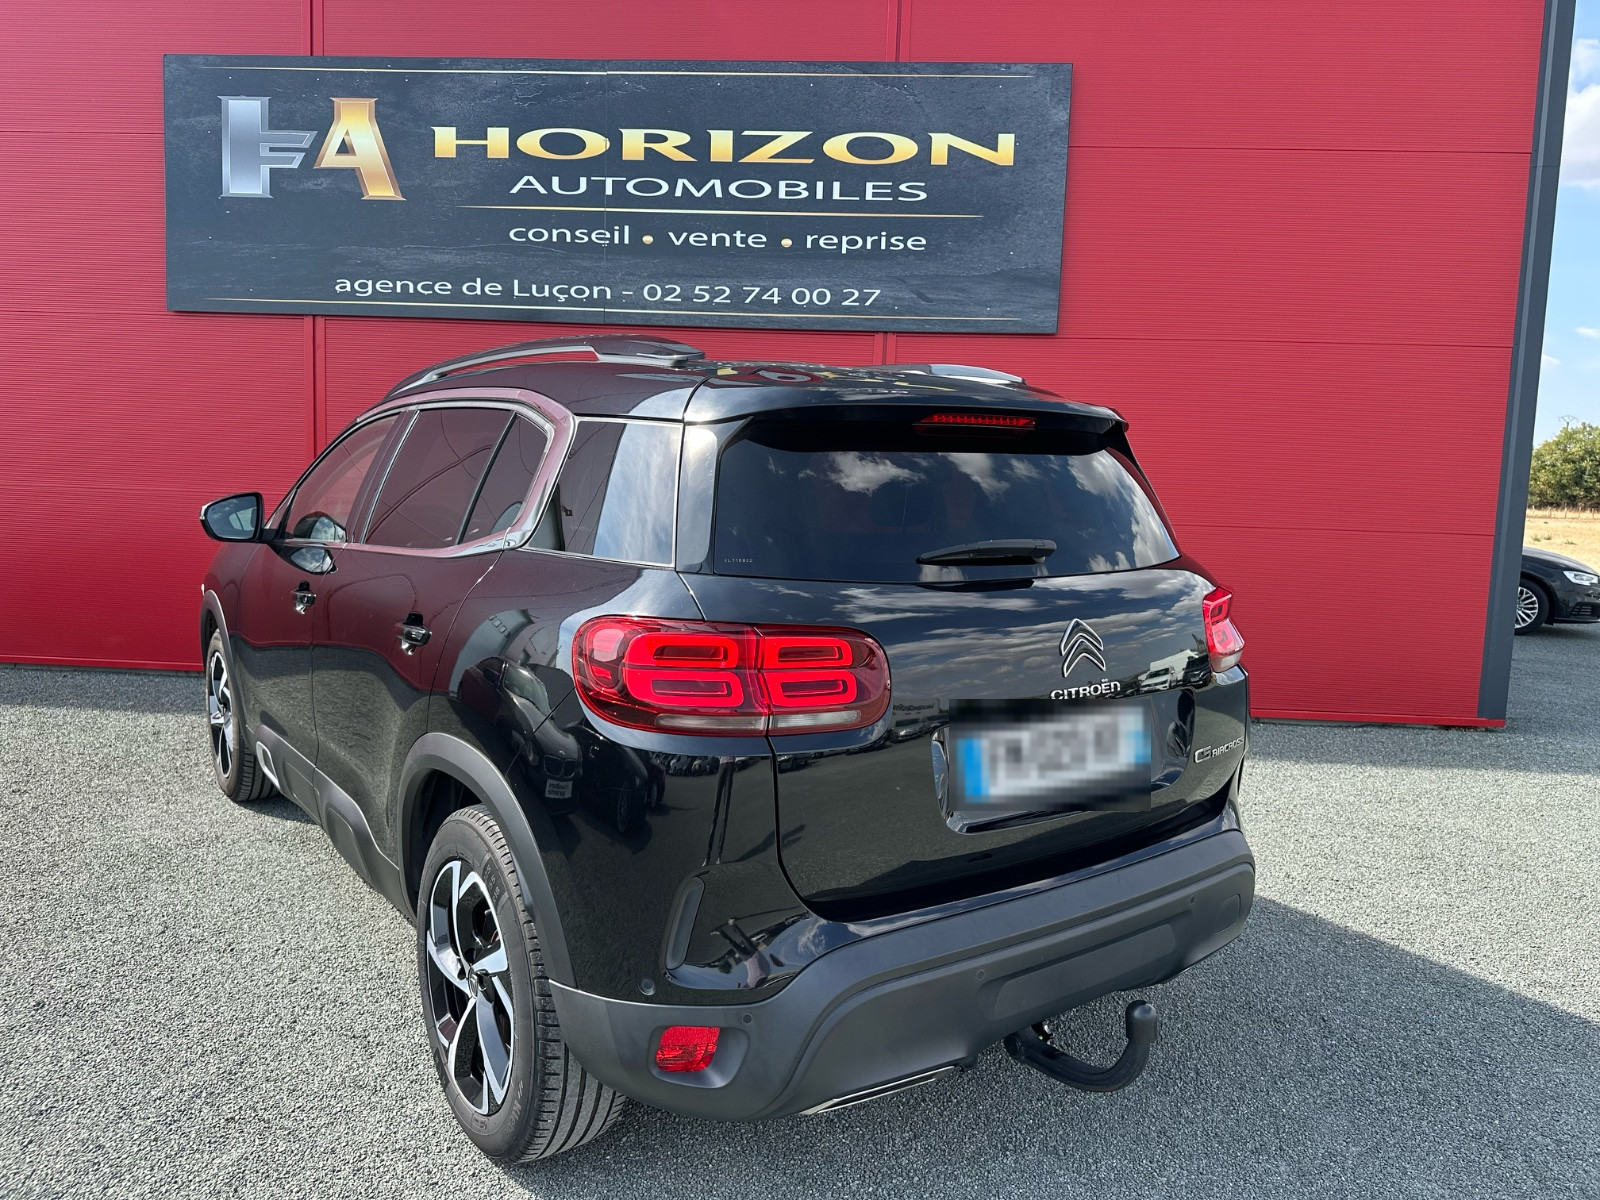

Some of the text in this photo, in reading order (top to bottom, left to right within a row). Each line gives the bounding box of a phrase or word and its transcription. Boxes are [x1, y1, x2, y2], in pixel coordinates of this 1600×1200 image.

[431, 126, 1016, 166] HORIZON
[509, 175, 928, 202] AUTOMOBILES
[508, 225, 927, 254] conseil vente reprise
[335, 278, 453, 297] agence
[461, 277, 503, 296] de
[513, 279, 612, 302] Luçon
[643, 284, 682, 302] 02
[692, 285, 731, 304] 52
[742, 286, 782, 305] 74
[791, 287, 831, 306] 00
[841, 288, 881, 307] 27
